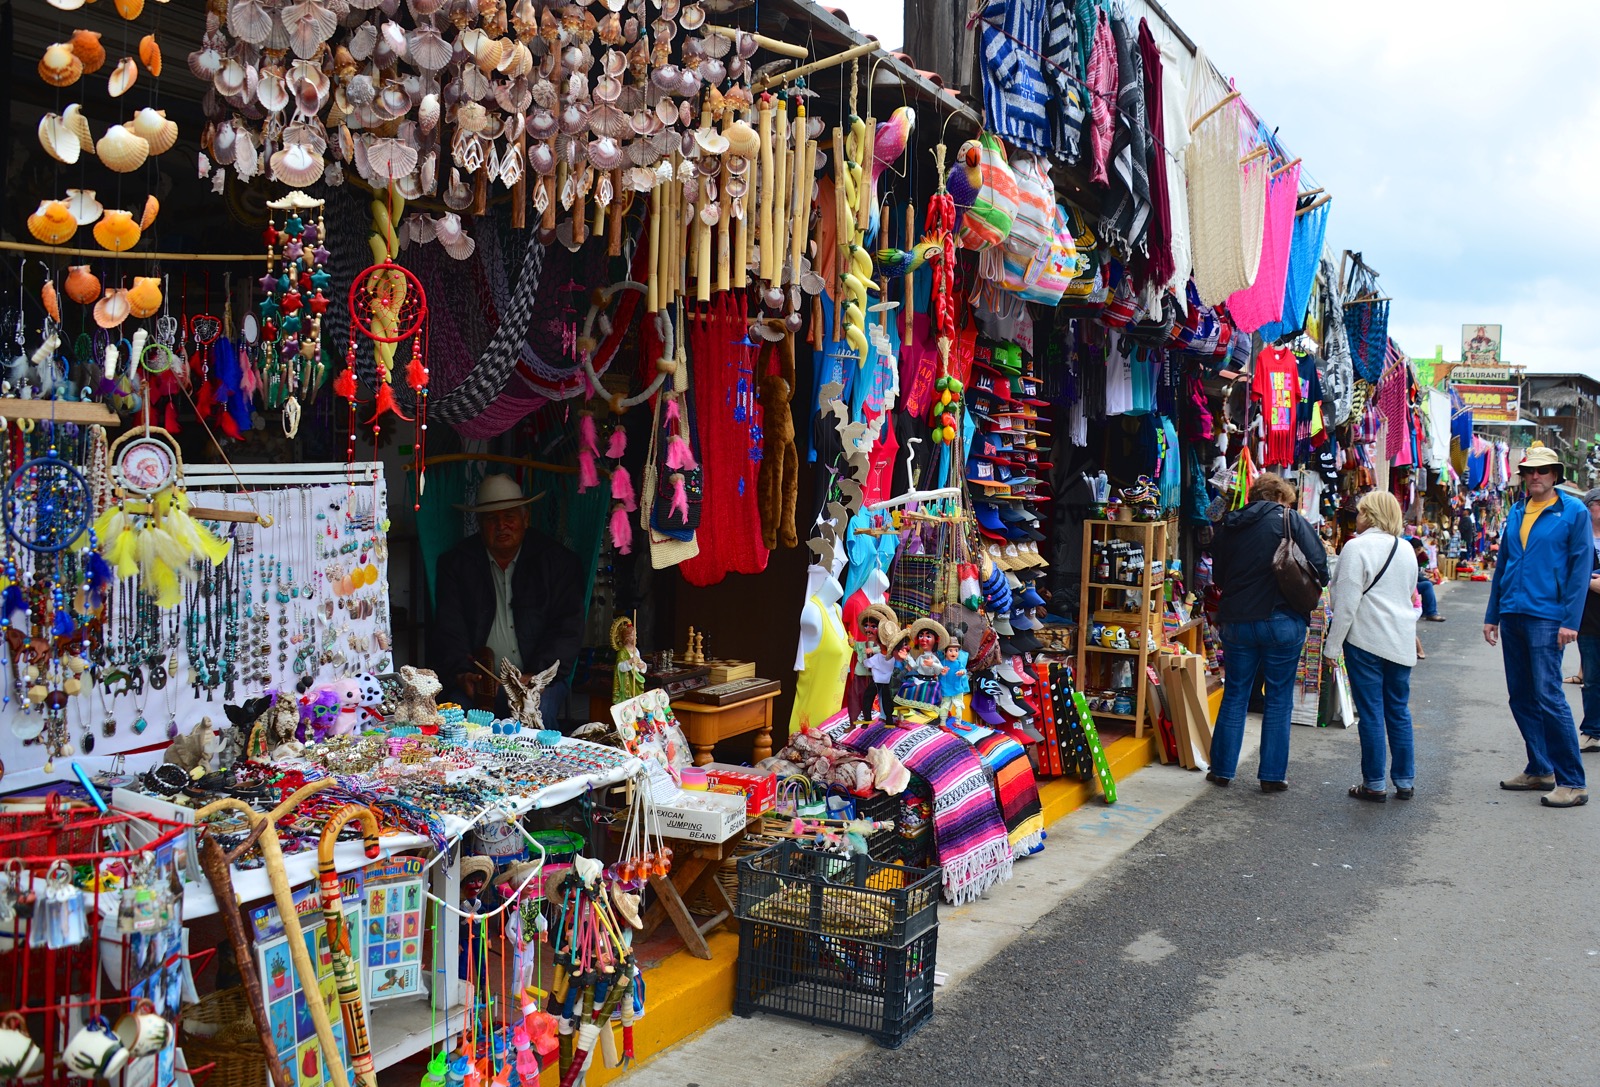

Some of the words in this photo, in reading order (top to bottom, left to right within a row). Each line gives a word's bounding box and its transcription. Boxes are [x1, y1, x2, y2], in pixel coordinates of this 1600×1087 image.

[1463, 393, 1501, 405] TACOS
[650, 809, 685, 819] MEXICAN
[667, 820, 703, 831] JUMPING
[729, 816, 745, 834] BEANS
[689, 831, 717, 841] BEANS
[407, 859, 421, 872] 10
[344, 877, 356, 897] 10
[295, 897, 319, 914] TERIA
